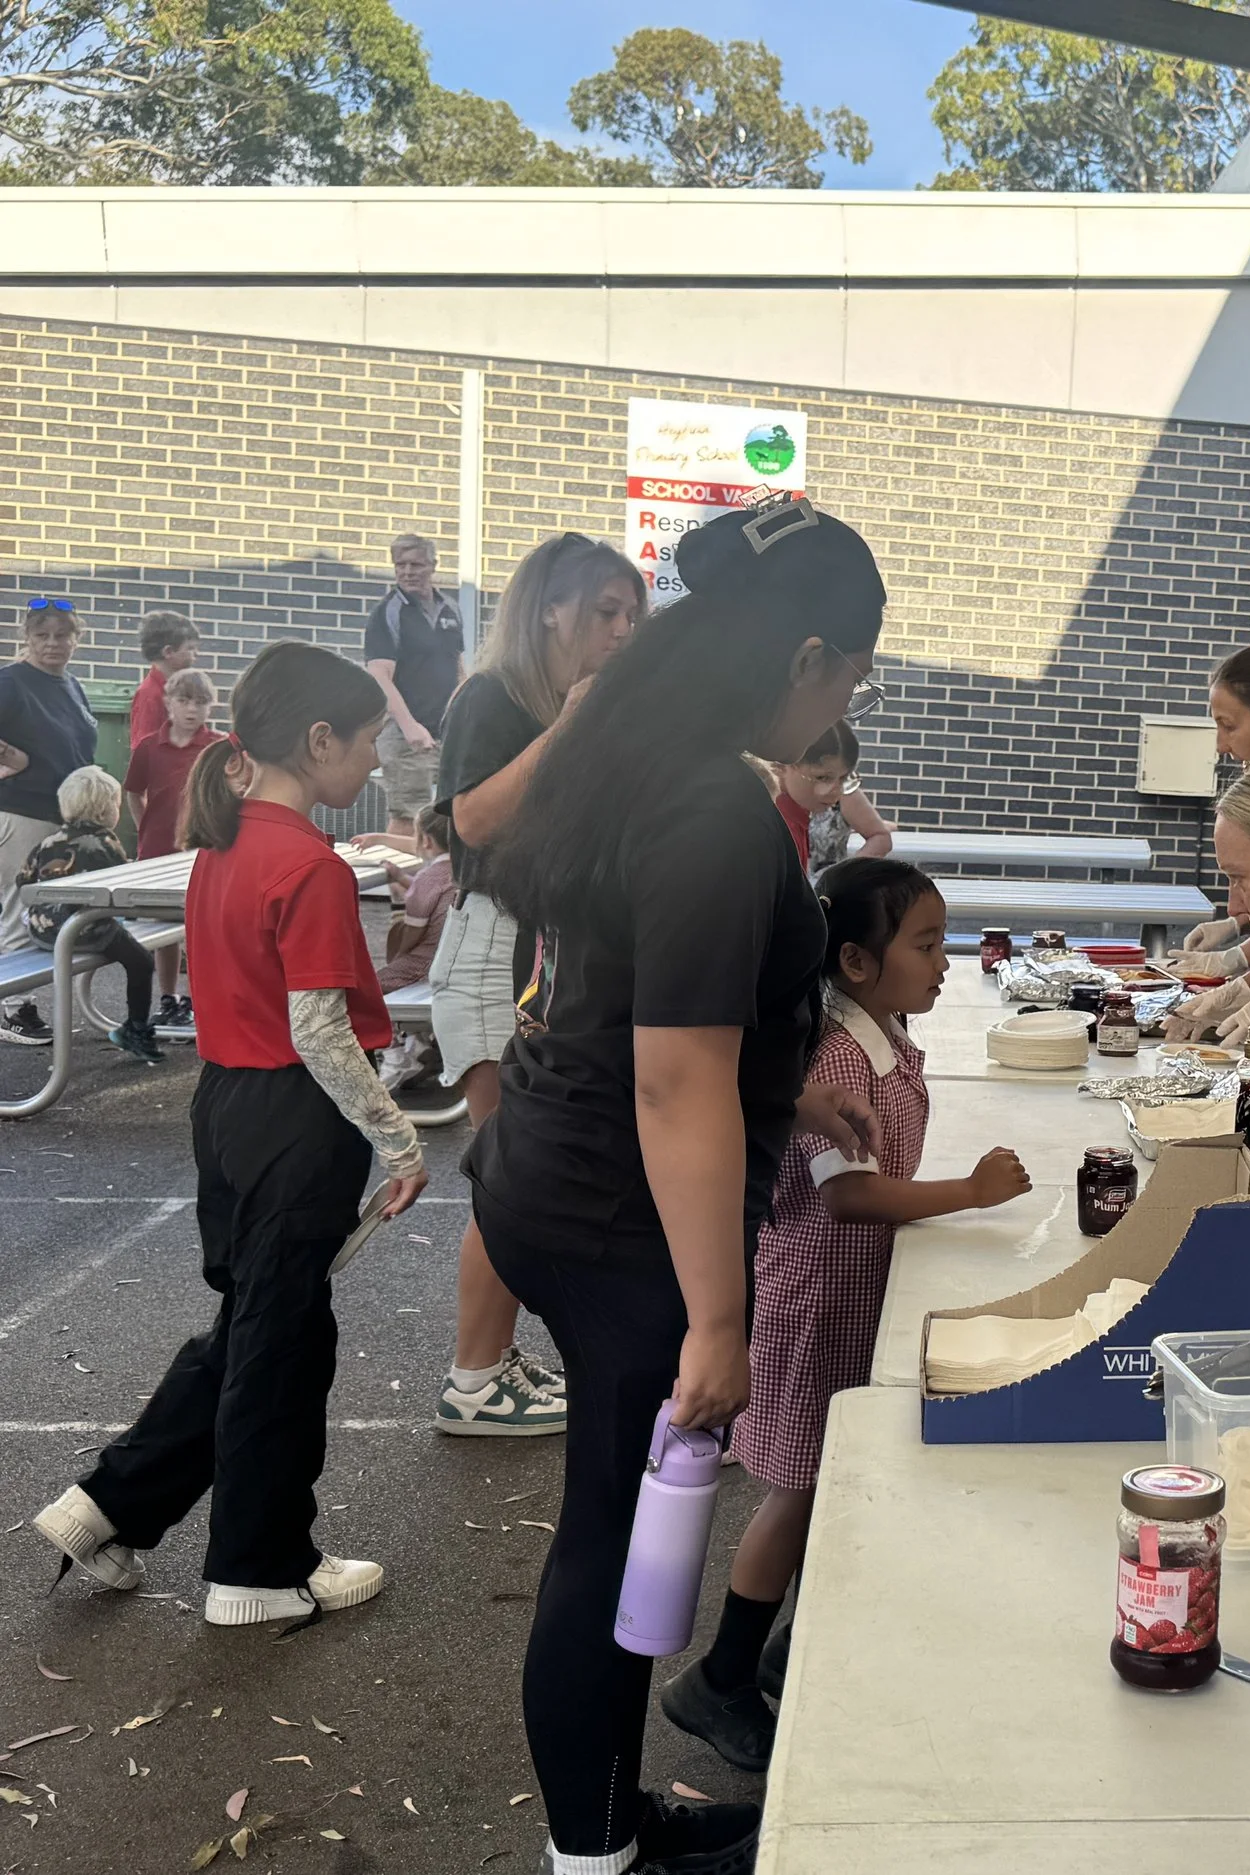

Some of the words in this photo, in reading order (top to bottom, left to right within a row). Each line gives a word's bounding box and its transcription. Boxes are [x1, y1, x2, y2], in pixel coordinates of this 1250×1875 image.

[642, 480, 716, 502] SCHOOL
[640, 511, 709, 533] Resp
[1094, 1199, 1119, 1212] Plum
[1103, 1353, 1150, 1372] WHI
[1121, 1572, 1182, 1597] STRAWBERRY
[1134, 1593, 1155, 1609] JAM
